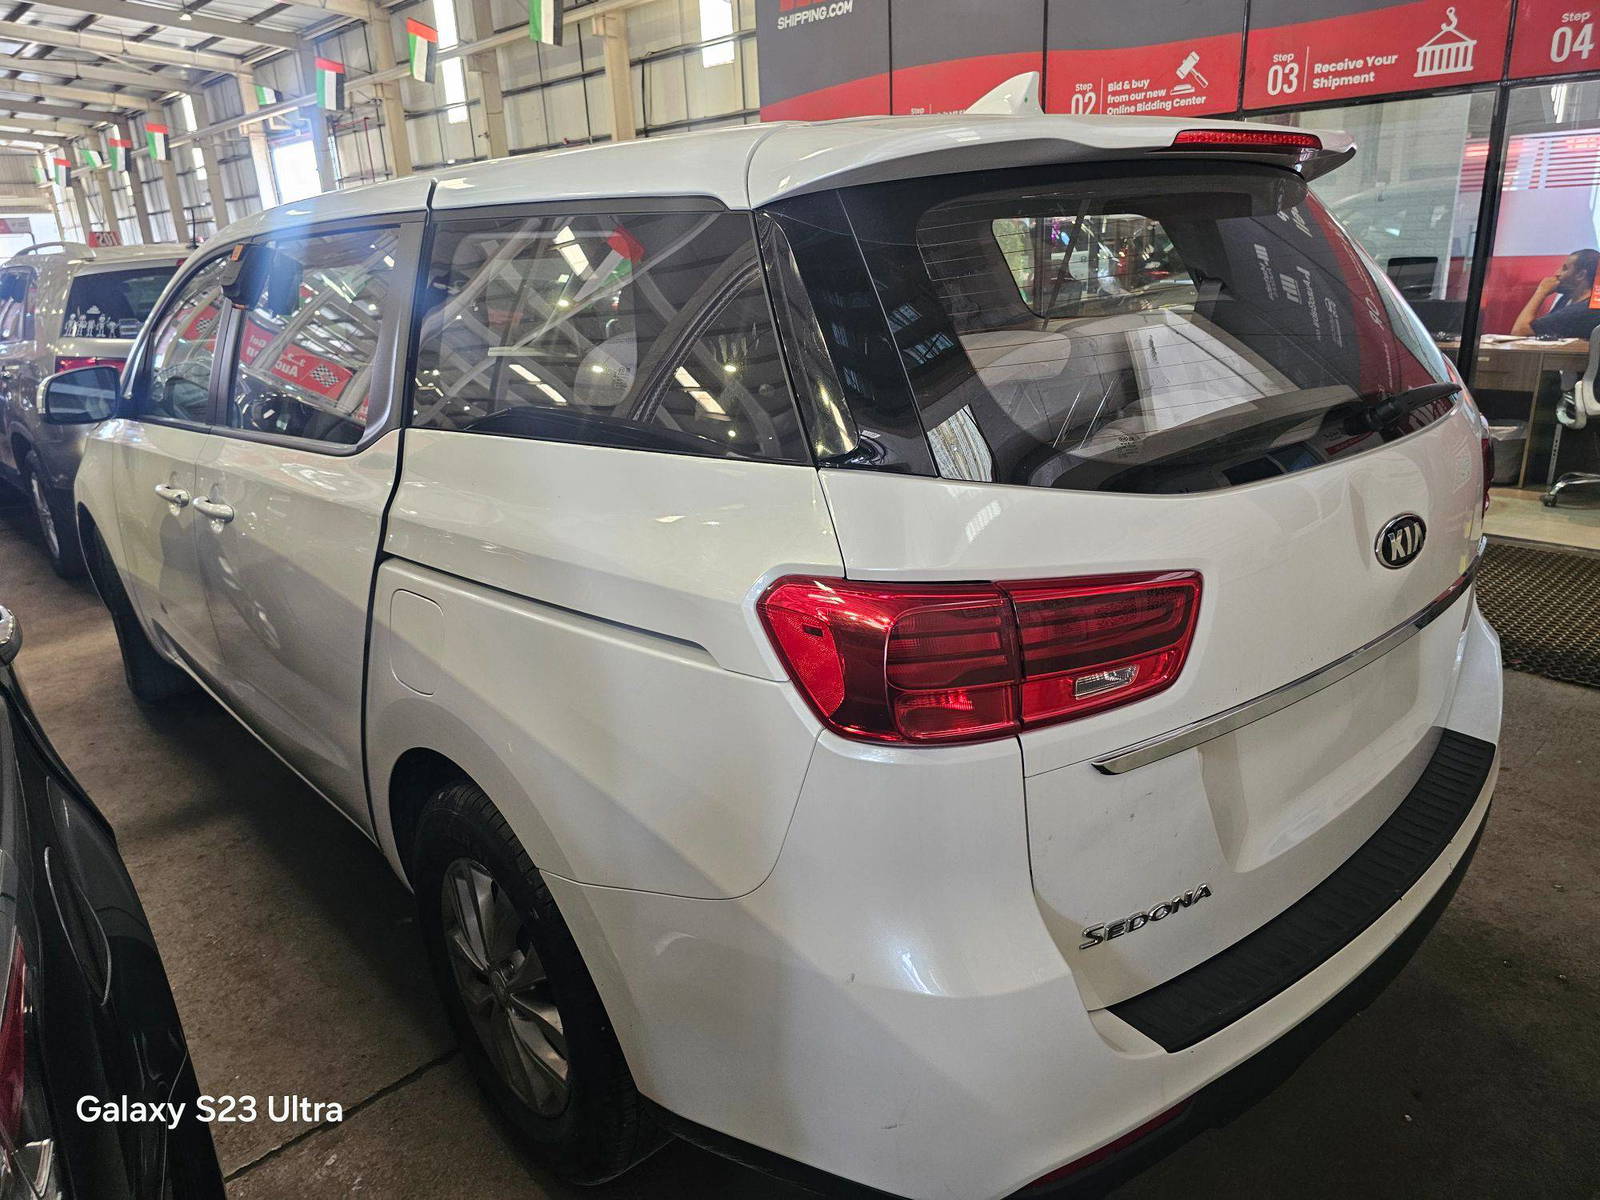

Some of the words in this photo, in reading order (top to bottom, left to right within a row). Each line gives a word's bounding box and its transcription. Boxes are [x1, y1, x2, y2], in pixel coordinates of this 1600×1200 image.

[777, 0, 853, 30] SHIPPING.COM
[1561, 11, 1591, 23] Step
[1550, 23, 1595, 62] 04
[1272, 53, 1294, 63] Step
[1313, 58, 1363, 74] Receive
[1365, 54, 1398, 67] Your
[1075, 83, 1093, 92] Step
[1107, 82, 1122, 92] Bid
[1123, 81, 1130, 90] &
[1131, 79, 1150, 90] buy
[1267, 63, 1299, 96] 03
[1312, 71, 1375, 90] Shipment
[1071, 92, 1096, 115] 02
[1106, 105, 1136, 116] Online
[1136, 100, 1171, 112] Bidding
[1173, 95, 1206, 107] Center
[1107, 94, 1129, 104] from
[1130, 91, 1146, 101] our
[1146, 89, 1166, 98] new
[1385, 520, 1424, 562] KIA
[1079, 882, 1212, 950] SEDONA
